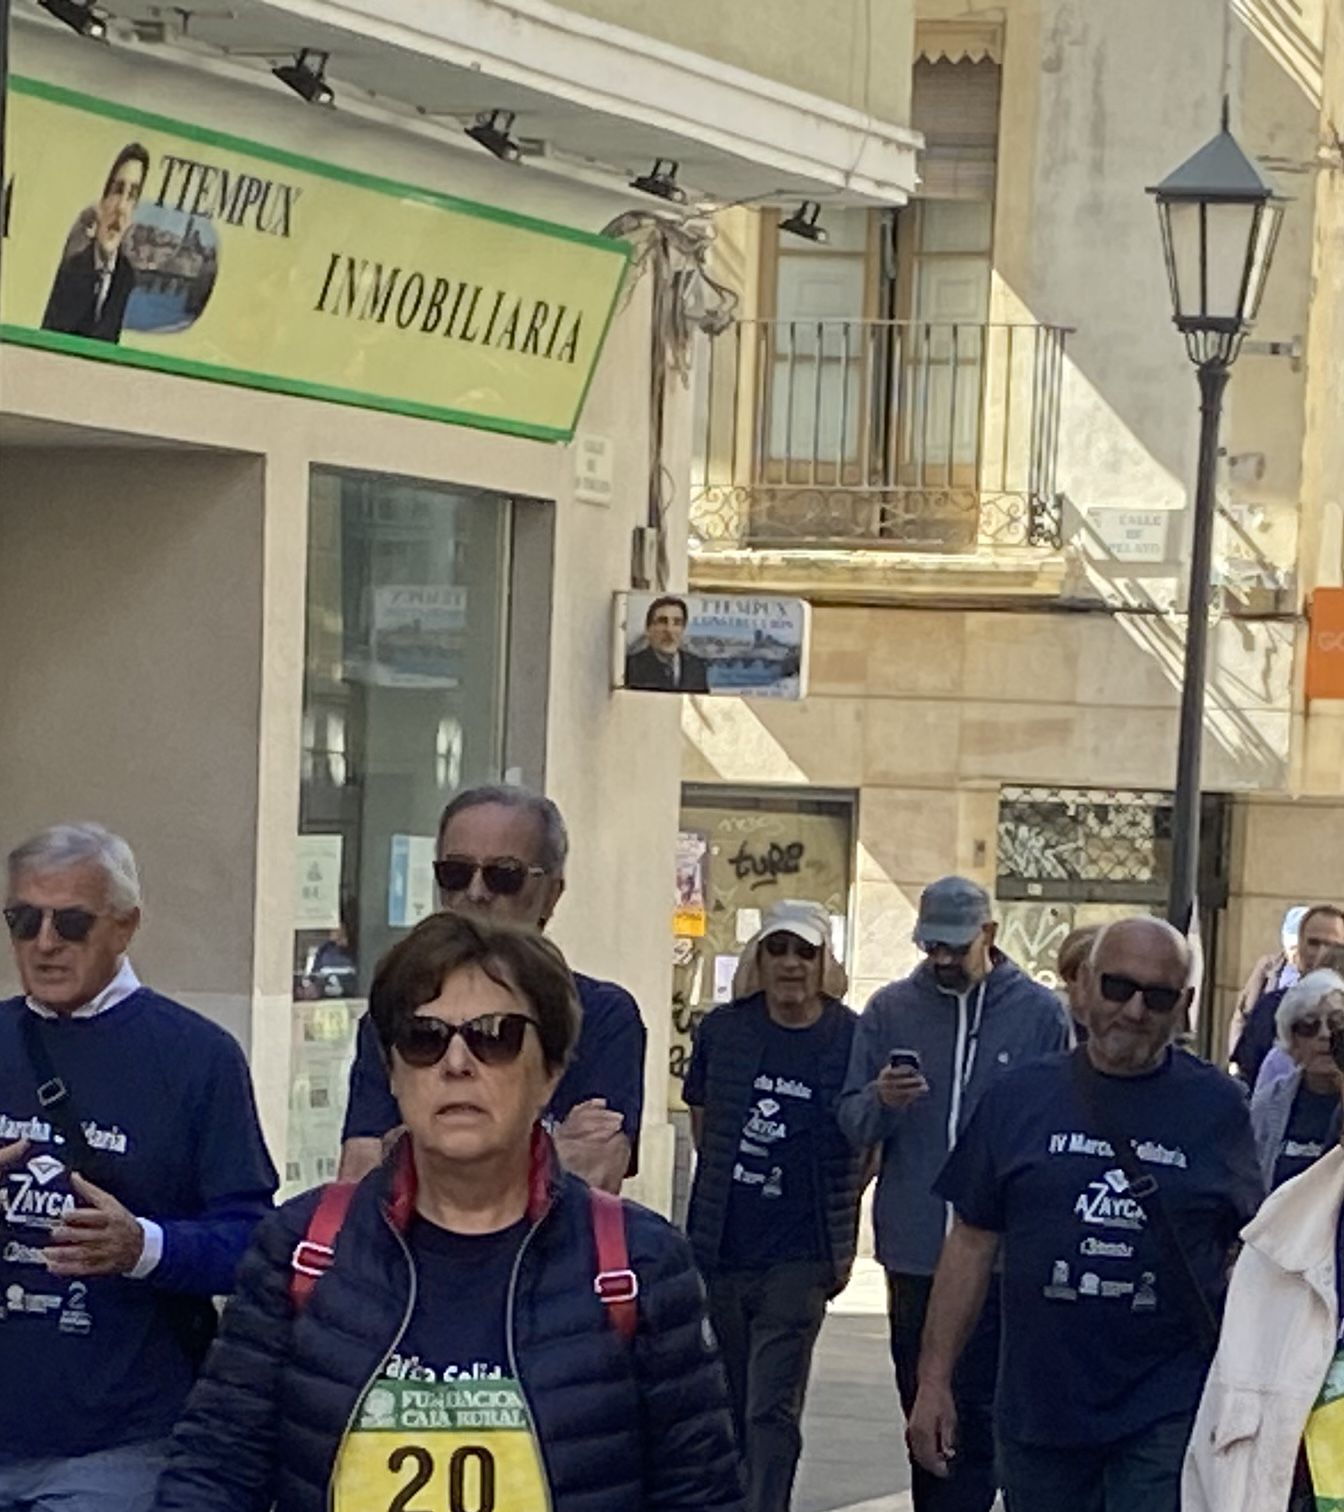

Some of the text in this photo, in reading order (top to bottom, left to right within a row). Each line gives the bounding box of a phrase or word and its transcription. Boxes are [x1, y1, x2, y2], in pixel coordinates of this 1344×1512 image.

[313, 252, 584, 364] INMOBILIARIA
[1049, 1133, 1068, 1154] IV
[456, 1409, 527, 1428] RURAL
